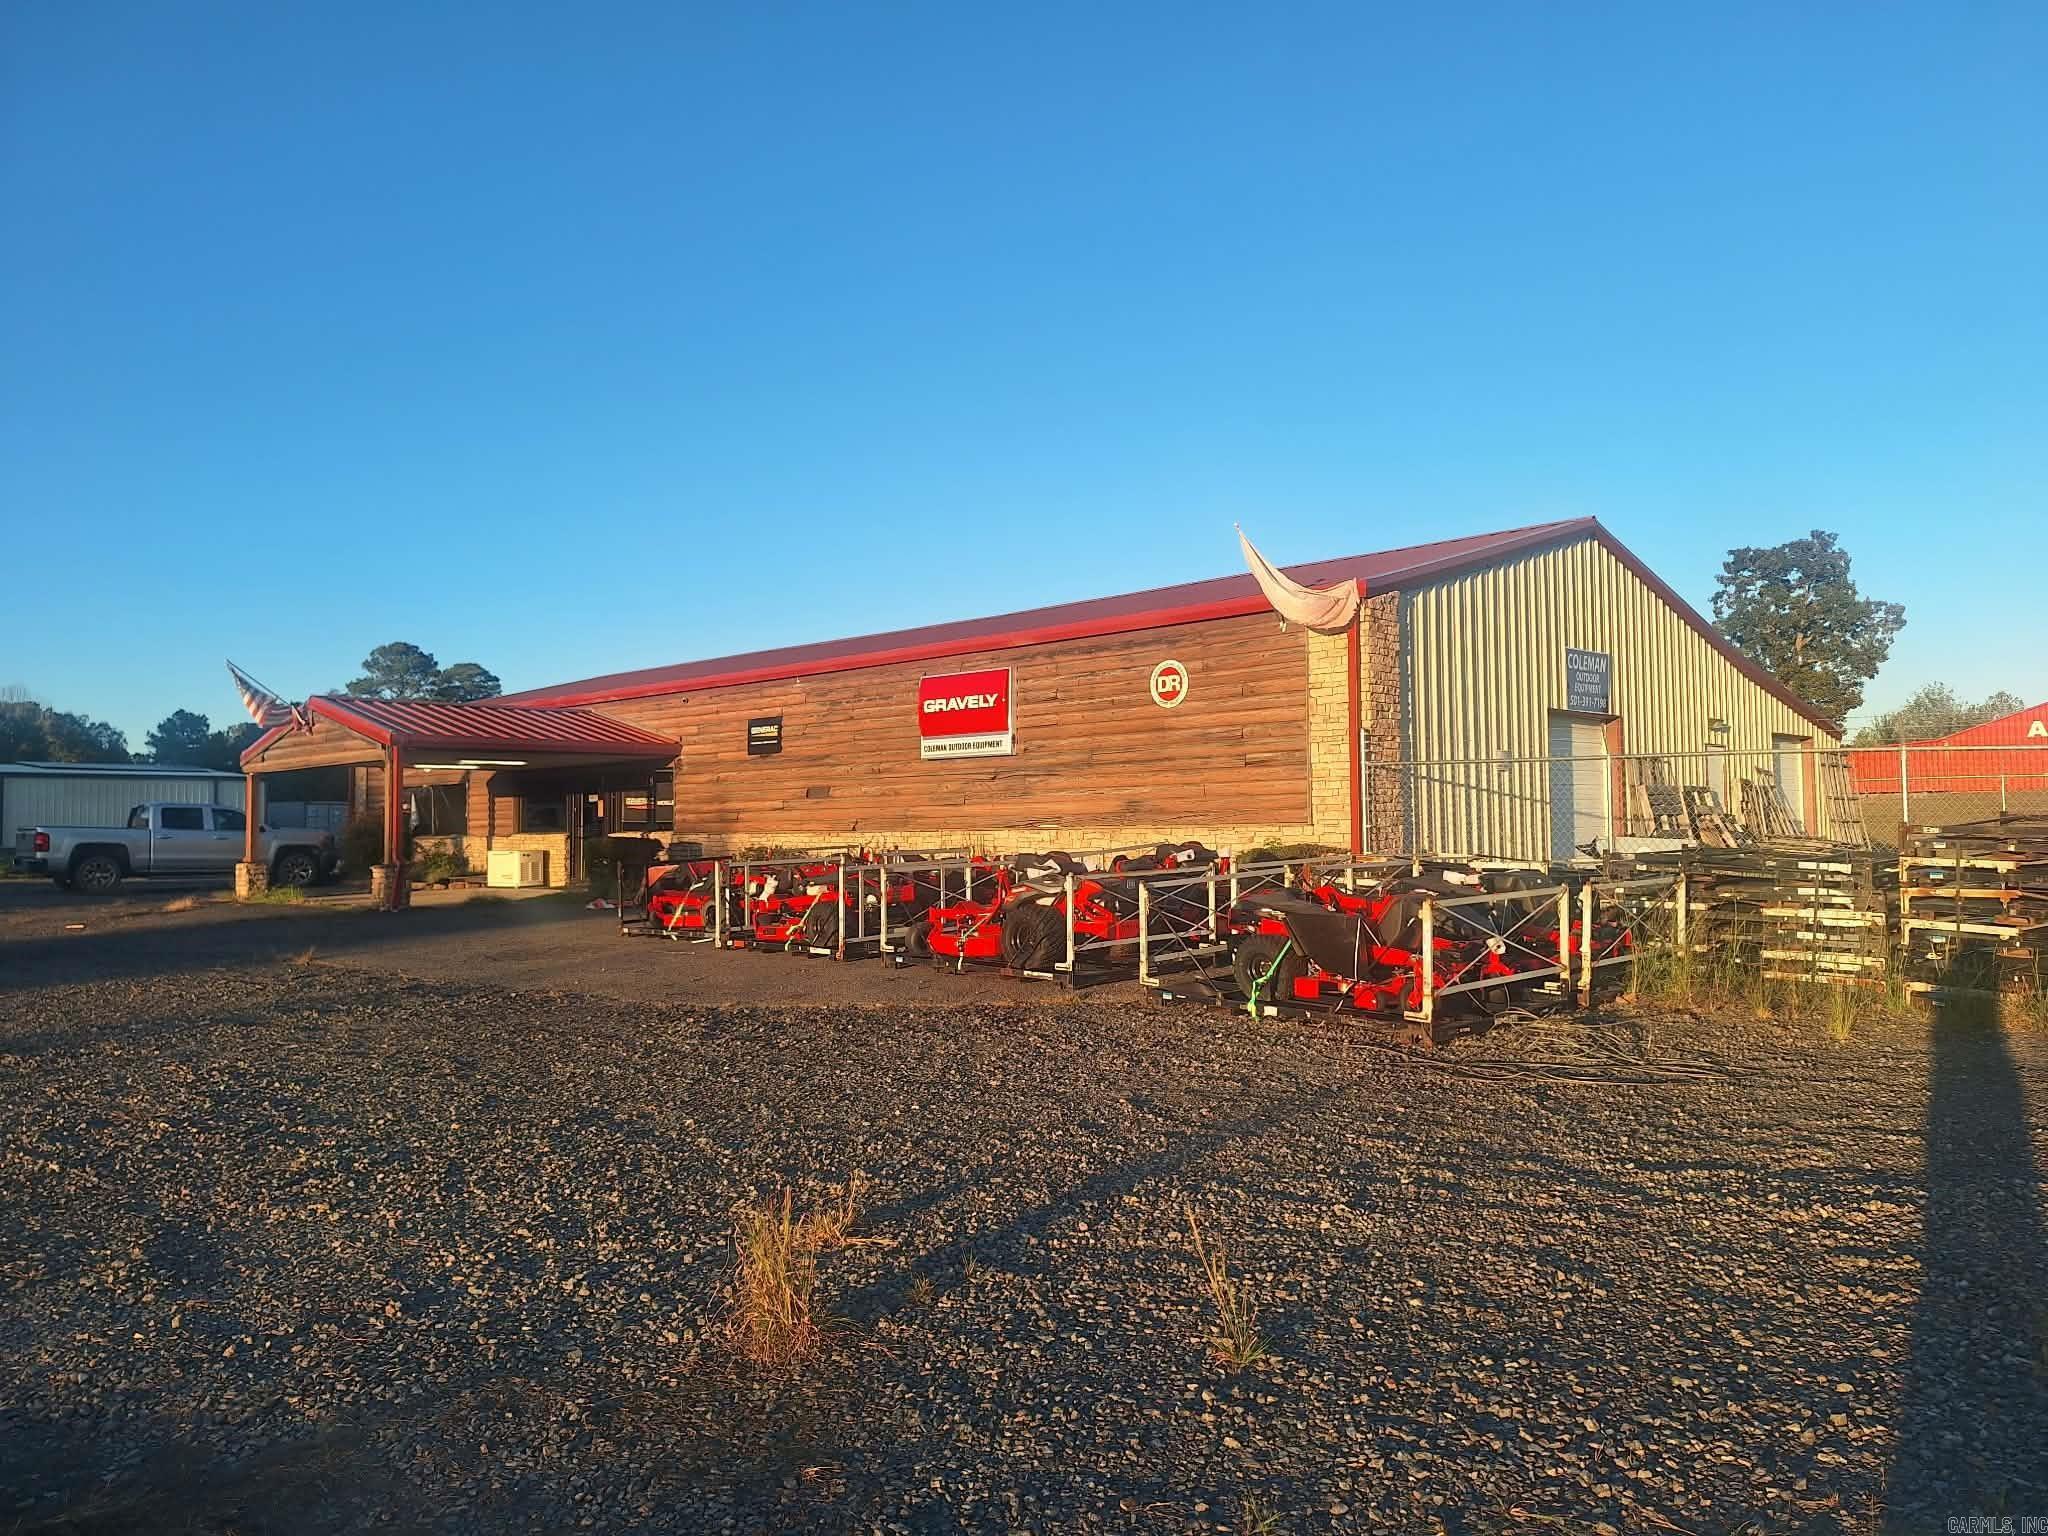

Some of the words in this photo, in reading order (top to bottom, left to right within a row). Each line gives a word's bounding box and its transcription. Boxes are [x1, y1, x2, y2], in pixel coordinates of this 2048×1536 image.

[1568, 654, 1607, 672] COLEMAN
[1157, 675, 1181, 692] DR
[1576, 672, 1600, 683] OUTDOOR
[1574, 682, 1601, 695] EQUIPMENT
[923, 694, 998, 713] GRAVELY
[2027, 720, 2048, 737] A
[923, 744, 948, 753] COLEMAN
[949, 743, 972, 752] OUTDOOR
[973, 740, 1003, 750] EQUIPMENT
